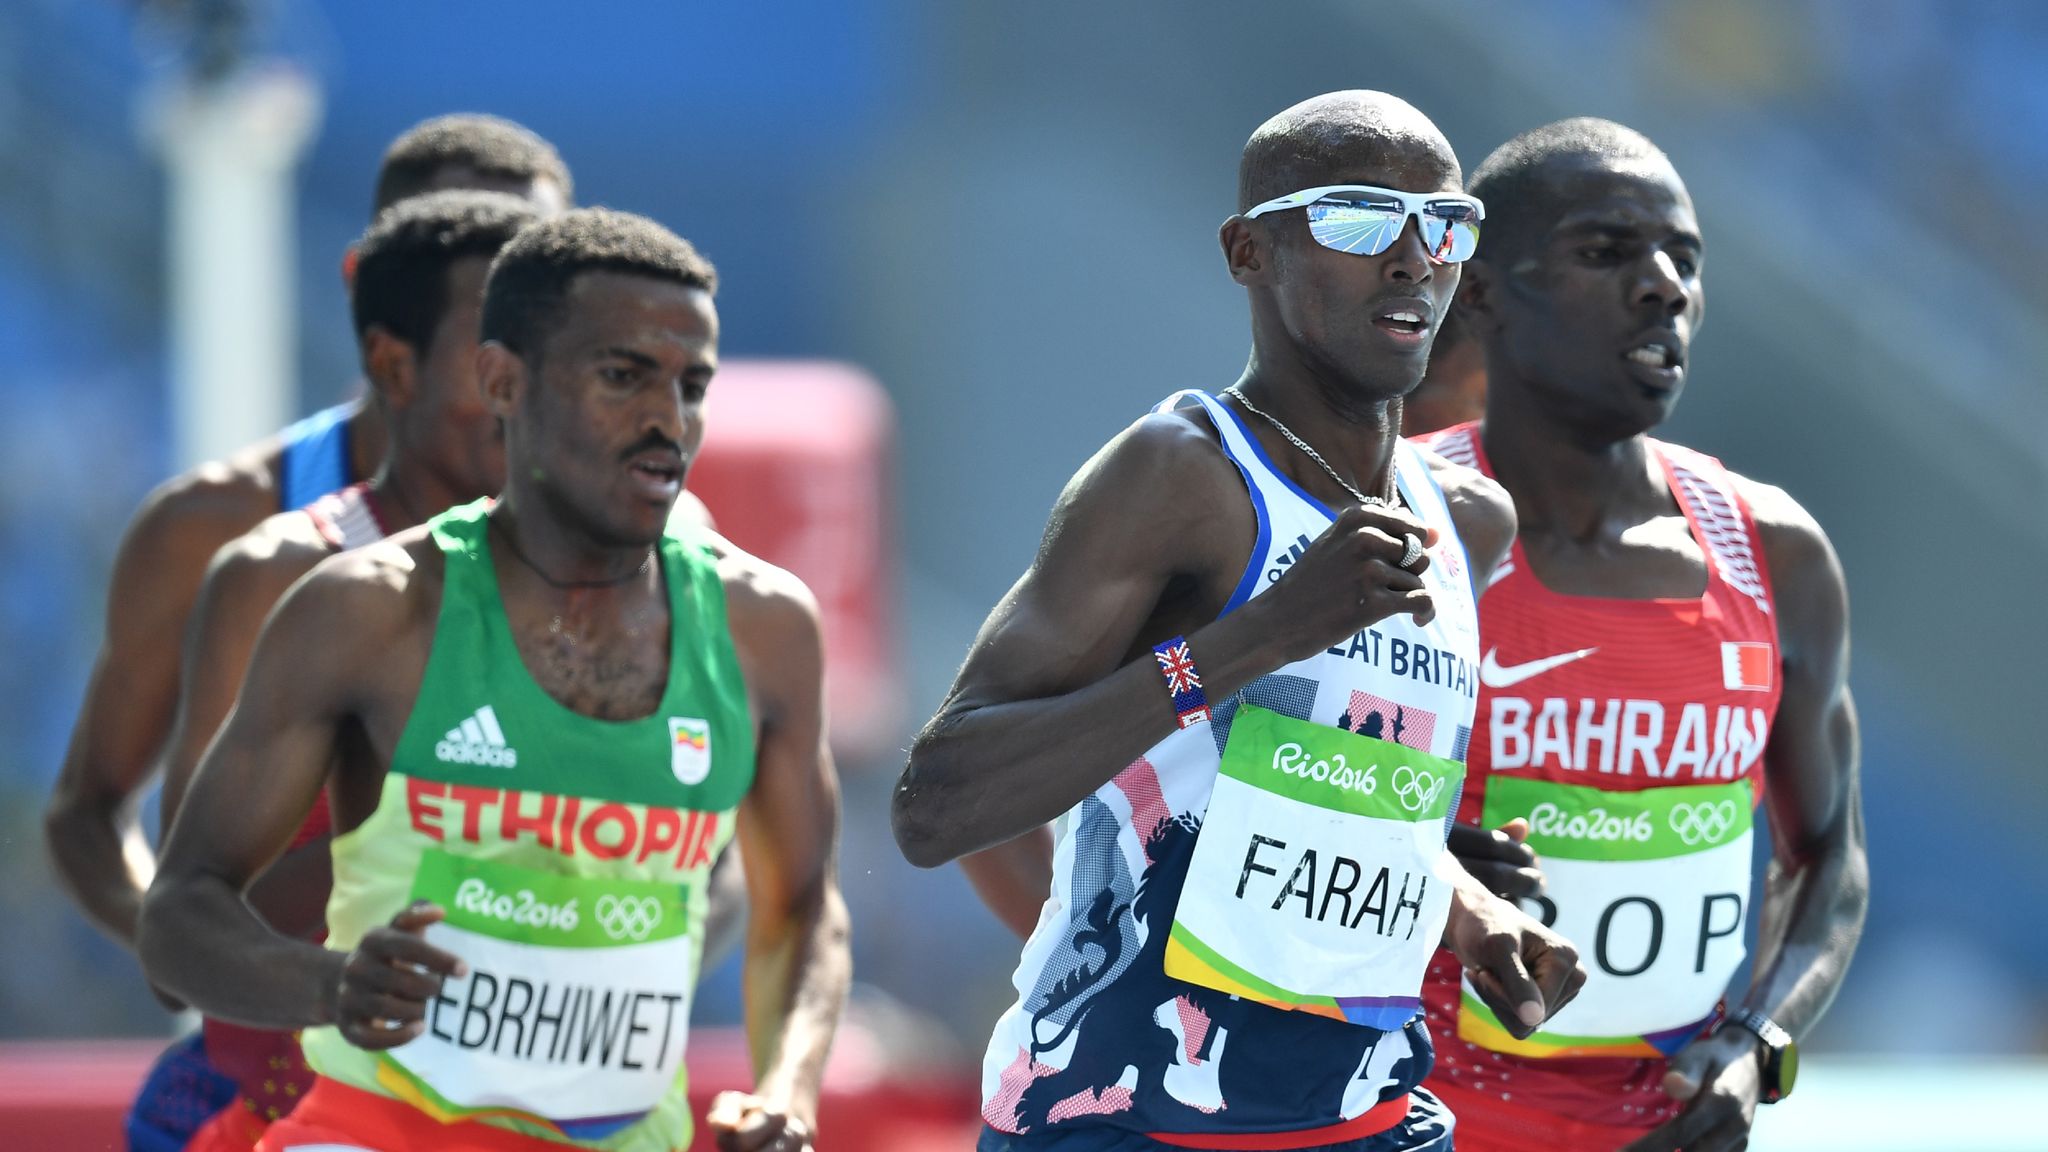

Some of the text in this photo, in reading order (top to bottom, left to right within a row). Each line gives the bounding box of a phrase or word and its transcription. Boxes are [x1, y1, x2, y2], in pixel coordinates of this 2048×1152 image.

[435, 740, 518, 769] adidas
[1489, 696, 1767, 779] BAHRAIN
[1272, 741, 1378, 797] Rio2016
[406, 776, 718, 871] ETHIOPIA
[1528, 802, 1654, 842] Rio2016
[455, 877, 580, 932] Rio2016
[1234, 833, 1428, 941] FARAH
